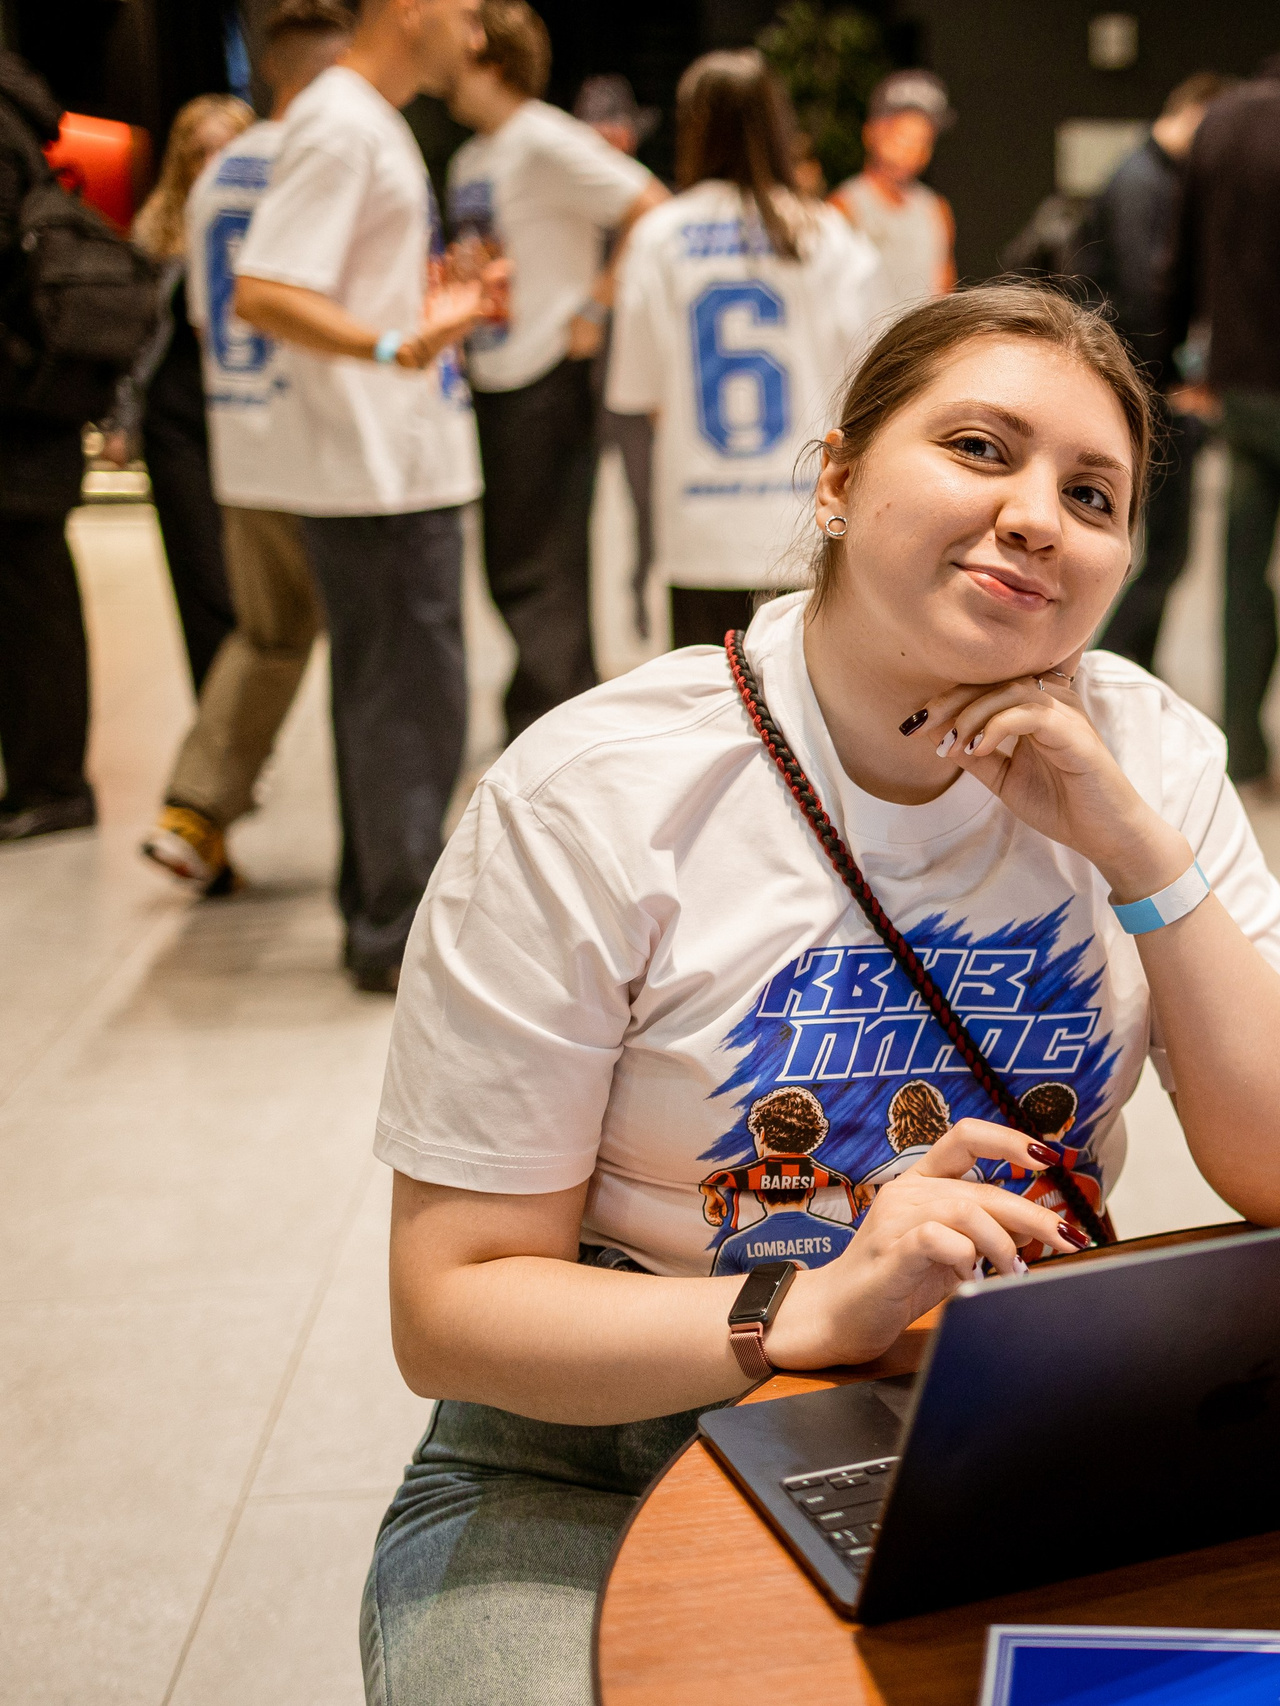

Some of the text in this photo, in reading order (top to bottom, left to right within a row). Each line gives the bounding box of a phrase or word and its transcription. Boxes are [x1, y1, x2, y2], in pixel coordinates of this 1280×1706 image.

[690, 280, 791, 457] 6
[760, 1174, 815, 1191] BARESI
[746, 1236, 832, 1259] LOMBAERTS
